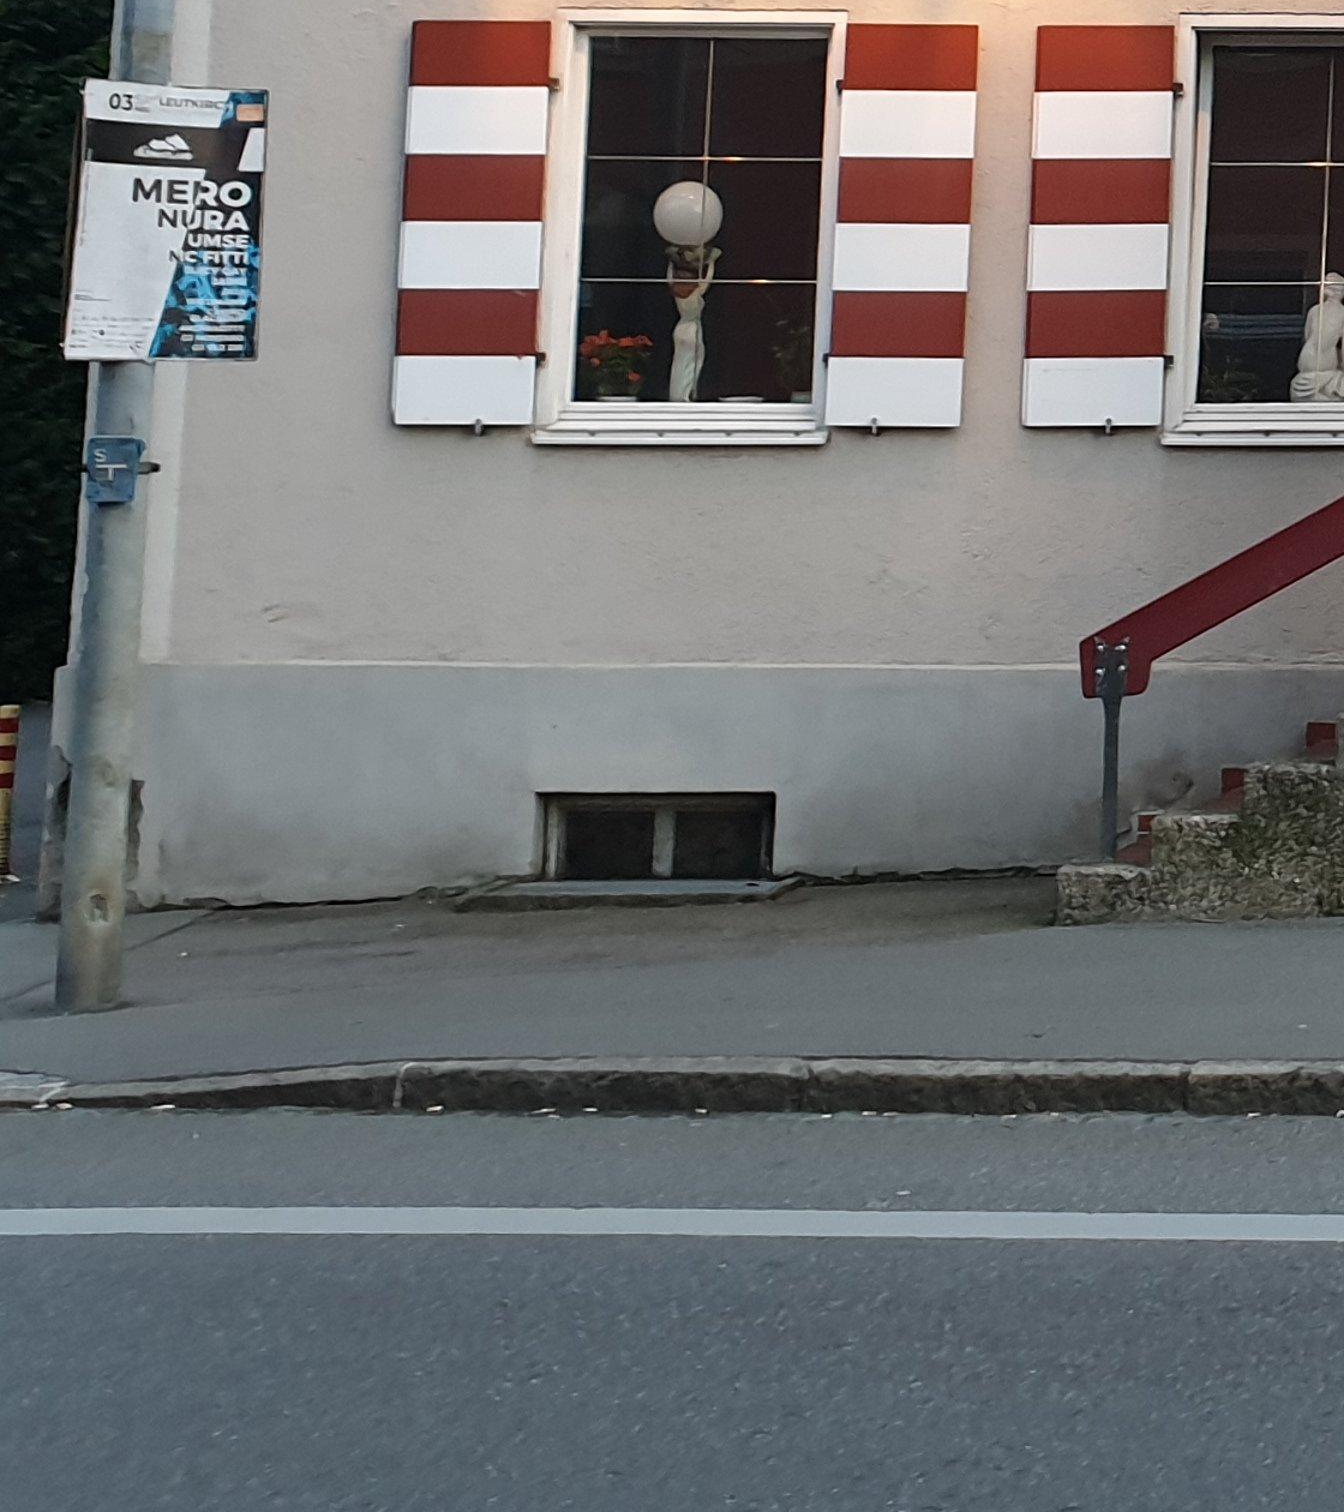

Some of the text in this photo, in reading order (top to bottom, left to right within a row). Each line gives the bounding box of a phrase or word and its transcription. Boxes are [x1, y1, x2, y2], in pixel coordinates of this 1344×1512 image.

[132, 178, 252, 208] MERO
[157, 208, 250, 231] NURA
[187, 233, 250, 249] UMSE
